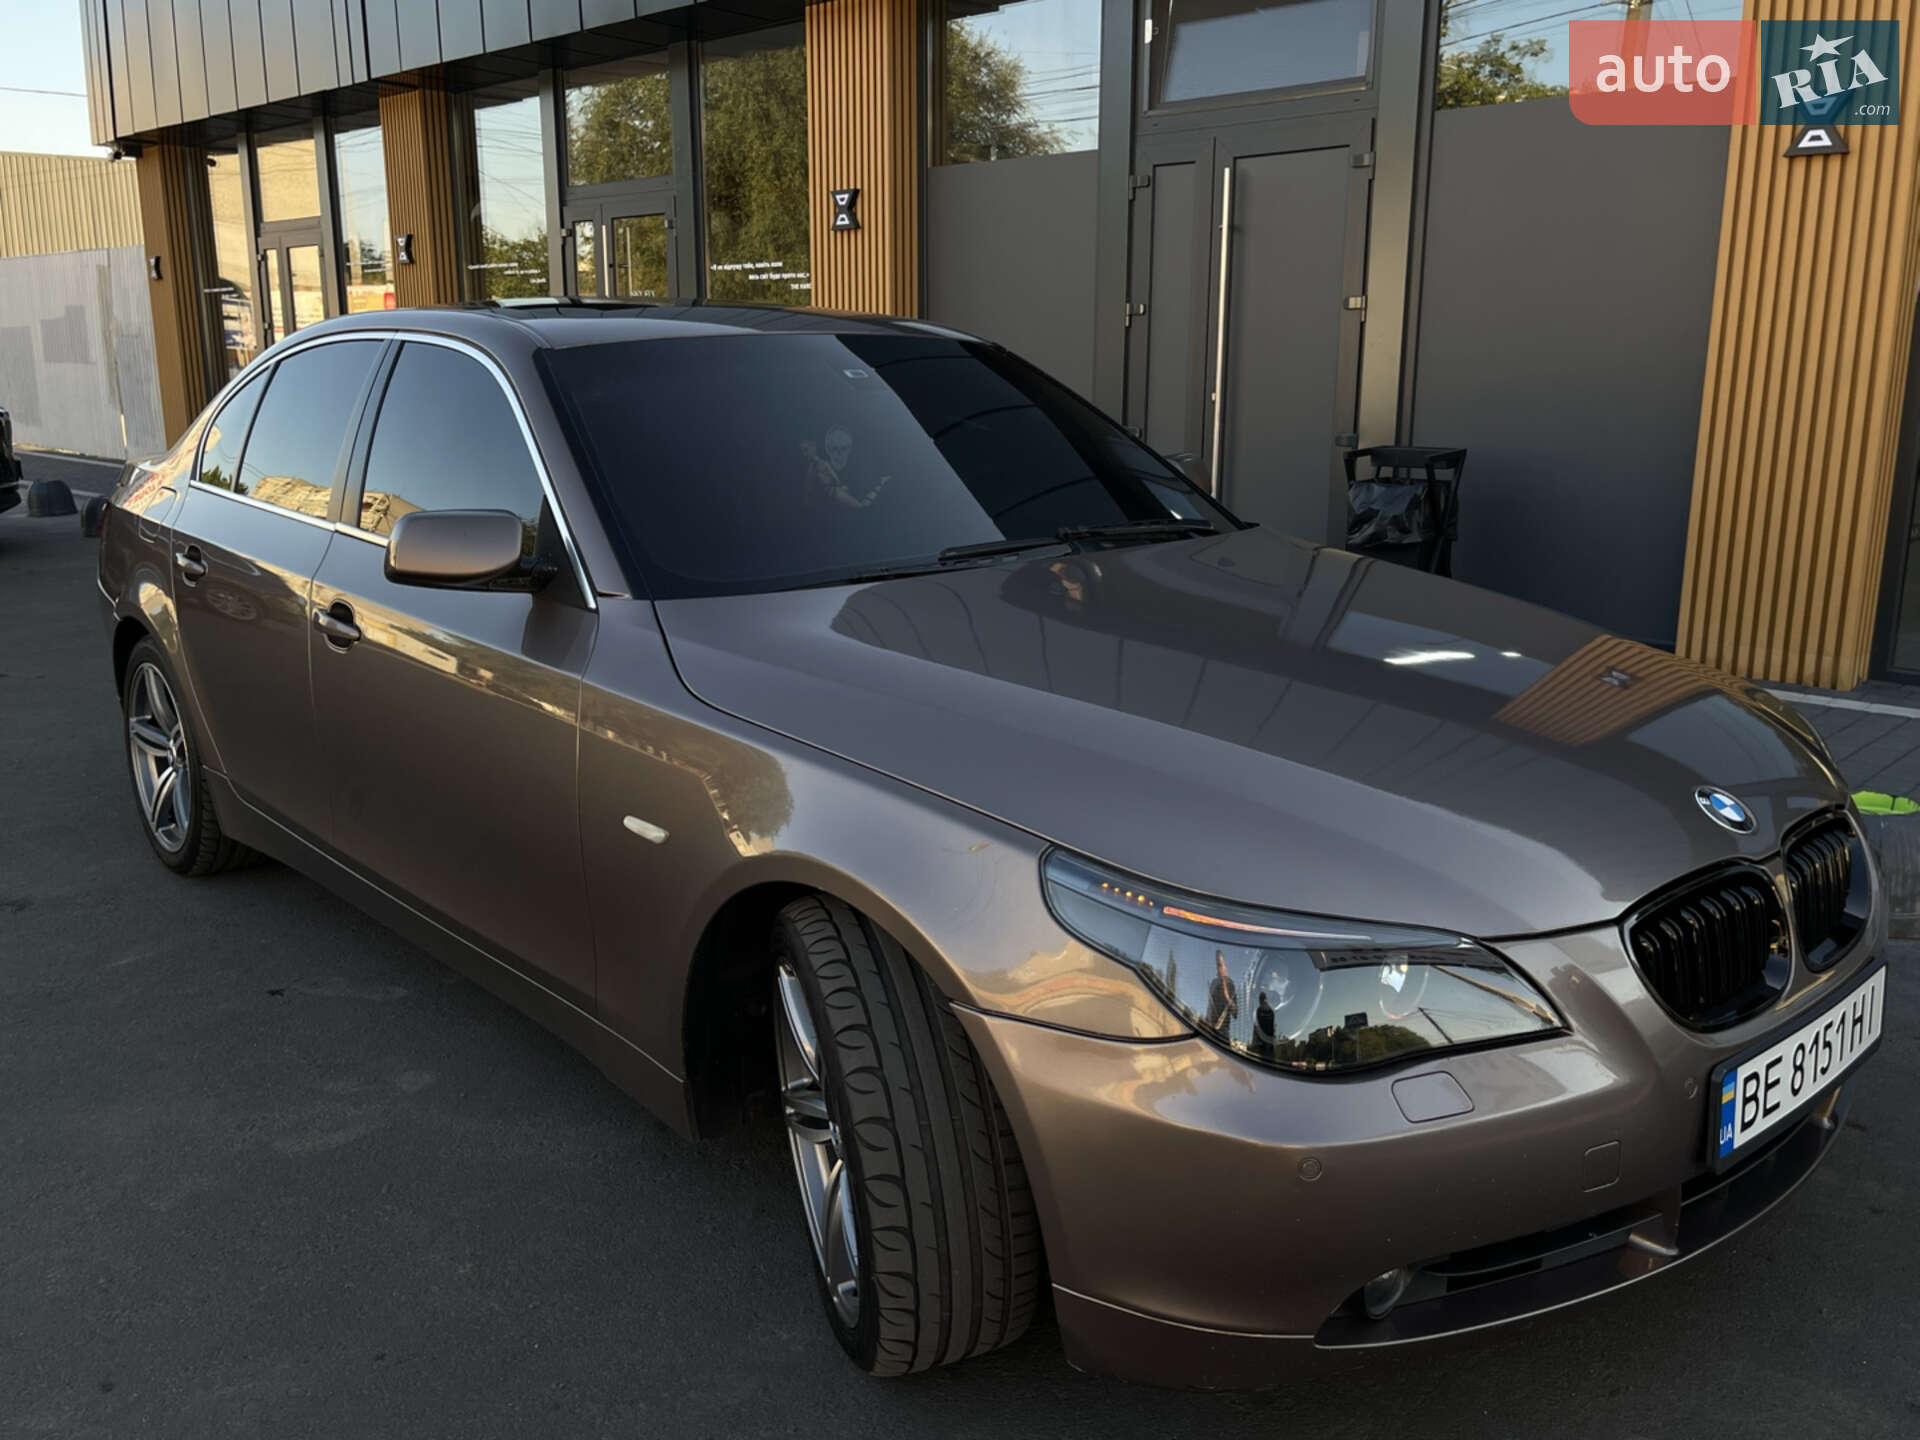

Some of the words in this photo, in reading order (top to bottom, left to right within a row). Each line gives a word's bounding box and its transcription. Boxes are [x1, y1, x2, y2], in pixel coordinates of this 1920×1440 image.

[1740, 1056, 1783, 1133] BE
[1791, 1011, 1846, 1097] 8151
[1851, 985, 1875, 1053] HI
[1719, 1124, 1733, 1145] UA
